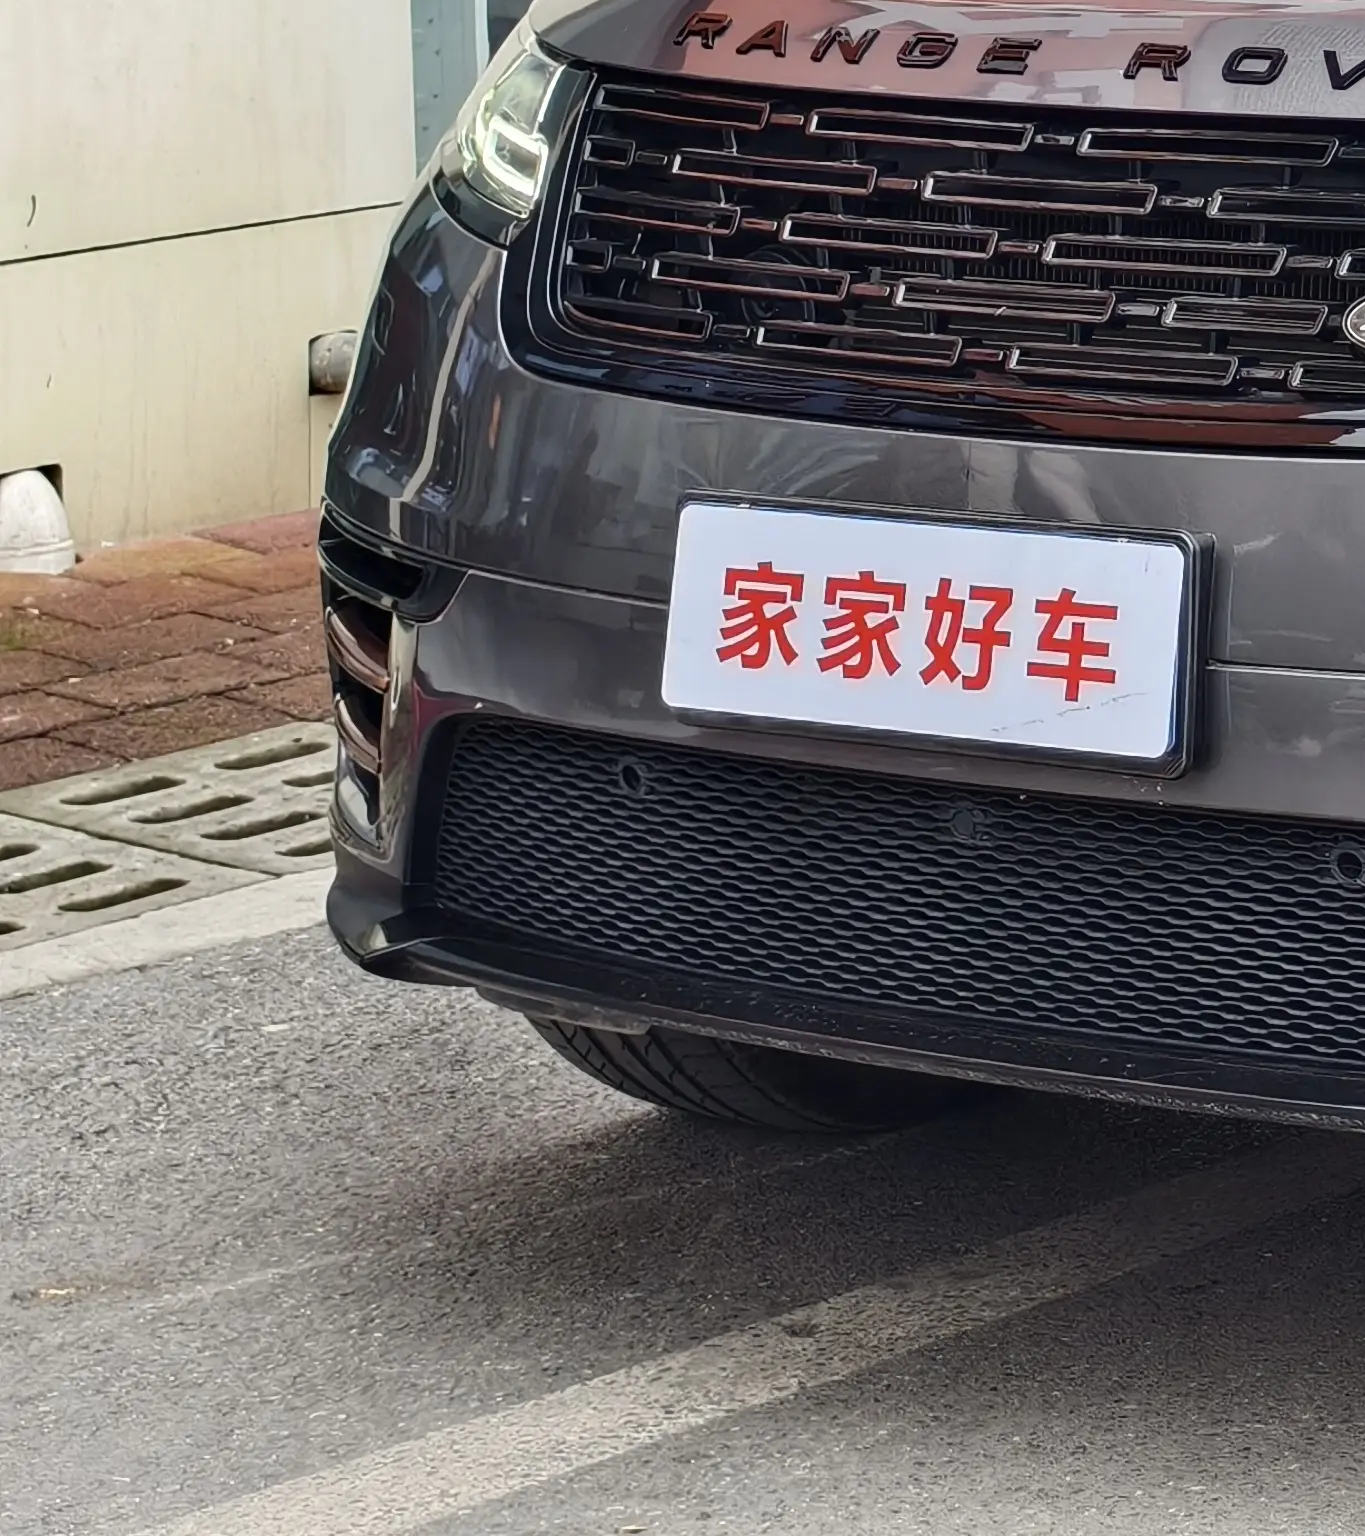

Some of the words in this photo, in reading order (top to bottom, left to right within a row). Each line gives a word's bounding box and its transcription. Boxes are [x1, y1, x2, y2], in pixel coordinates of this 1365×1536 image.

[673, 10, 1042, 76] RANGE
[715, 561, 1119, 703] 家家好车
